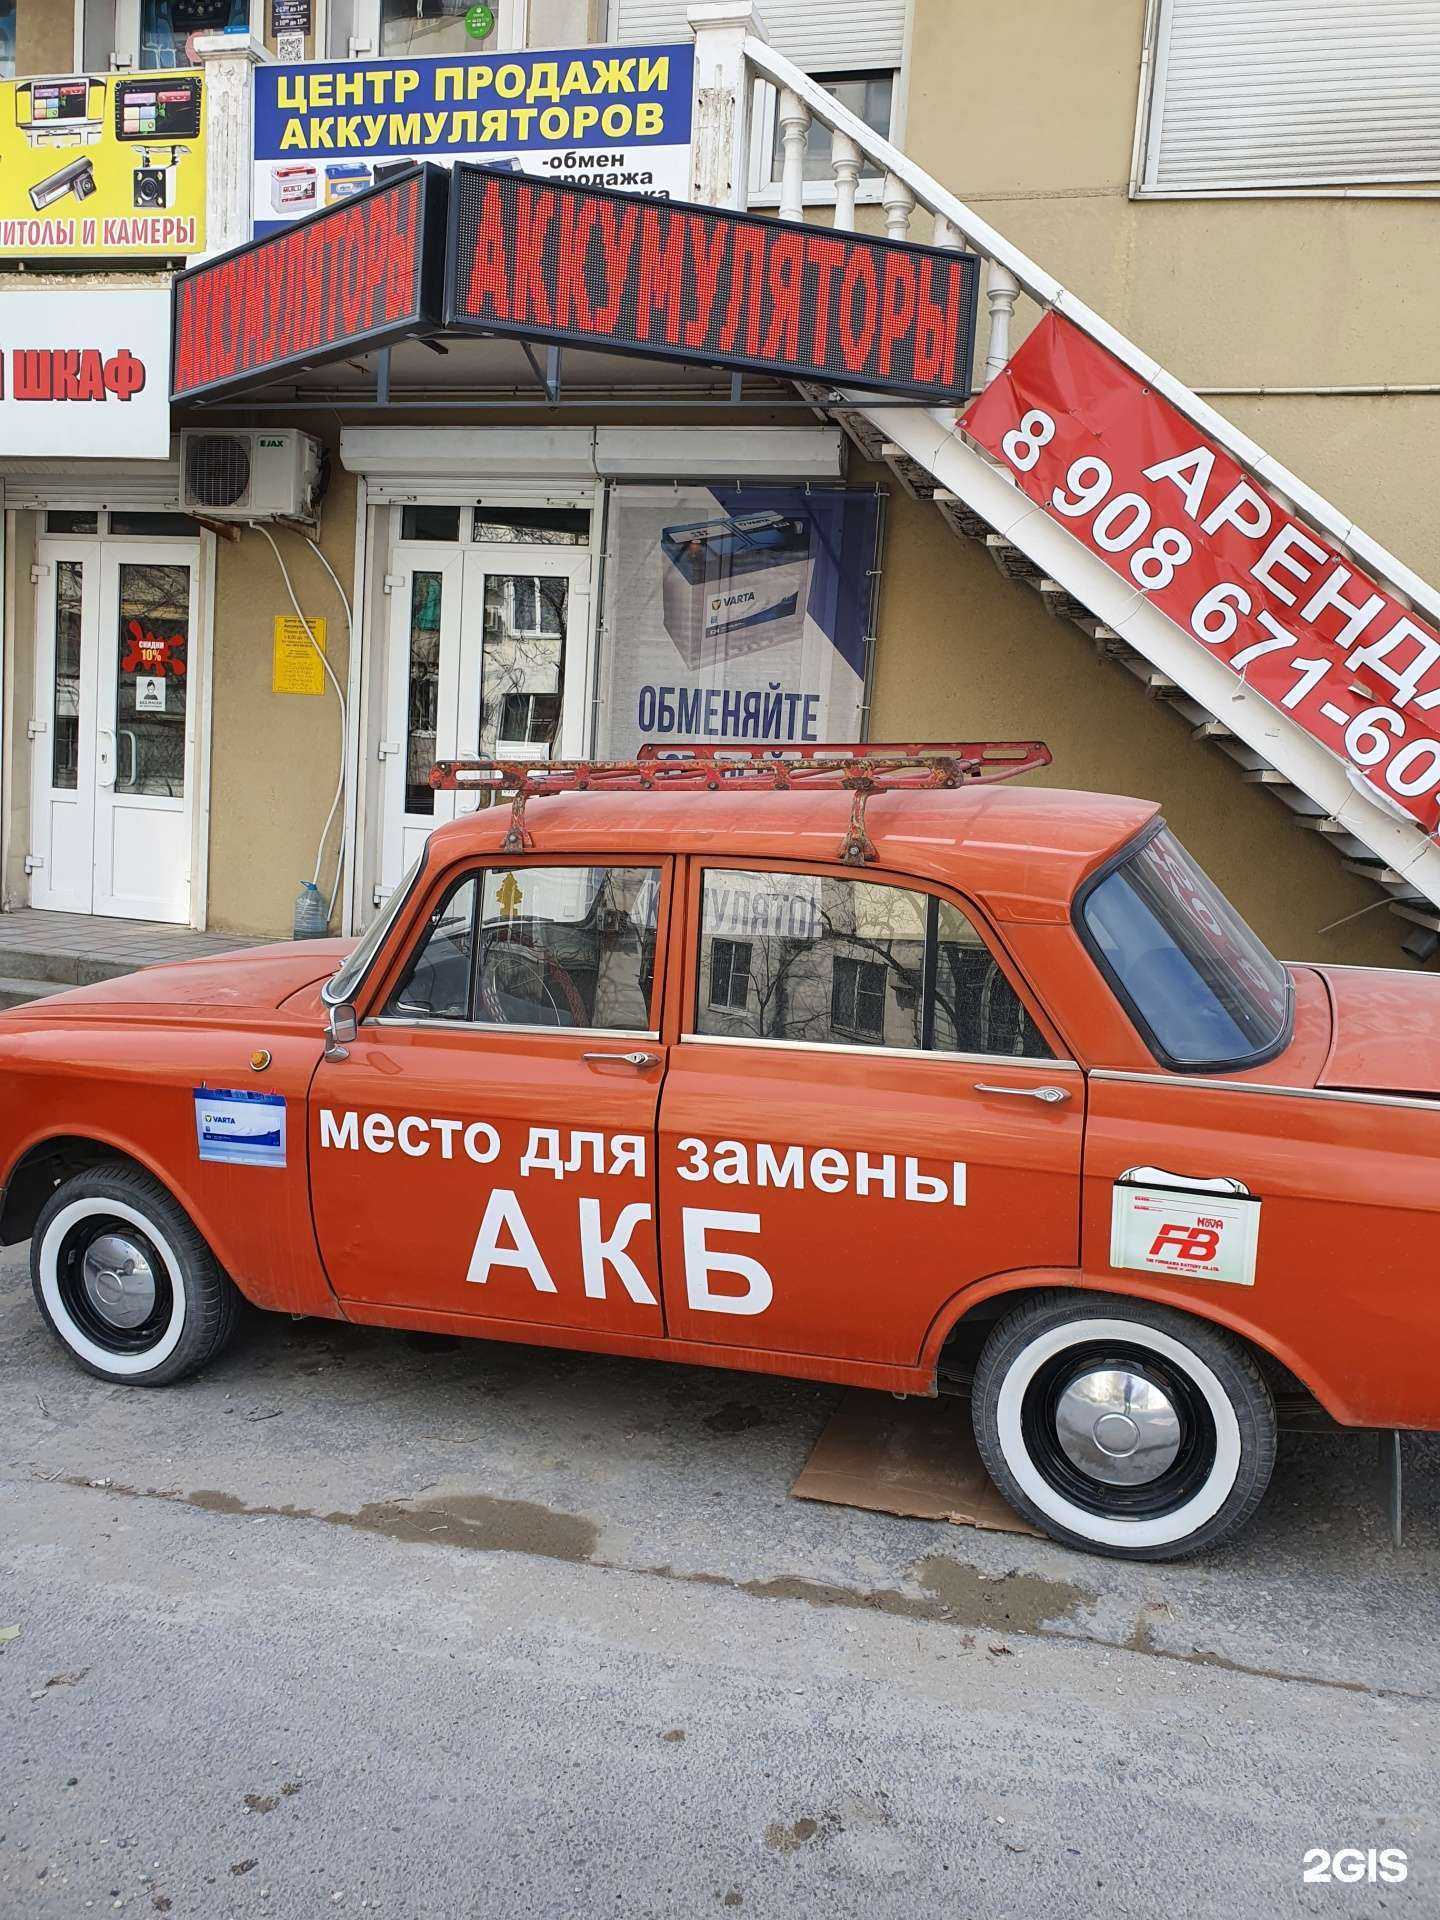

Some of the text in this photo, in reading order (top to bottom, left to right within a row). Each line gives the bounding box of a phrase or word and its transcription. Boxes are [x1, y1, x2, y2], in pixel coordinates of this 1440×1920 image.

[277, 56, 670, 115] ЦЕНТР ПРОДАЖИ
[279, 102, 665, 150] АККУМУЛЯТОРОВ
[542, 152, 625, 169] -обмен
[0, 218, 195, 246] ИТОЛЫ И КАМЕРЫ
[175, 181, 418, 392] АККУМУЛЯТОРЫ
[466, 181, 961, 385] АККУМУЛЯТОРЫ
[13, 349, 145, 401] ШКАФ
[723, 591, 755, 606] VARTA
[1002, 409, 1440, 838] 8 908 671-60
[141, 649, 162, 661] 10%
[638, 680, 821, 742] ОБМЕНЯЙТЕ
[213, 1116, 236, 1125] VARTA
[319, 1109, 967, 1206] место для замены
[1149, 1223, 1219, 1262] FB
